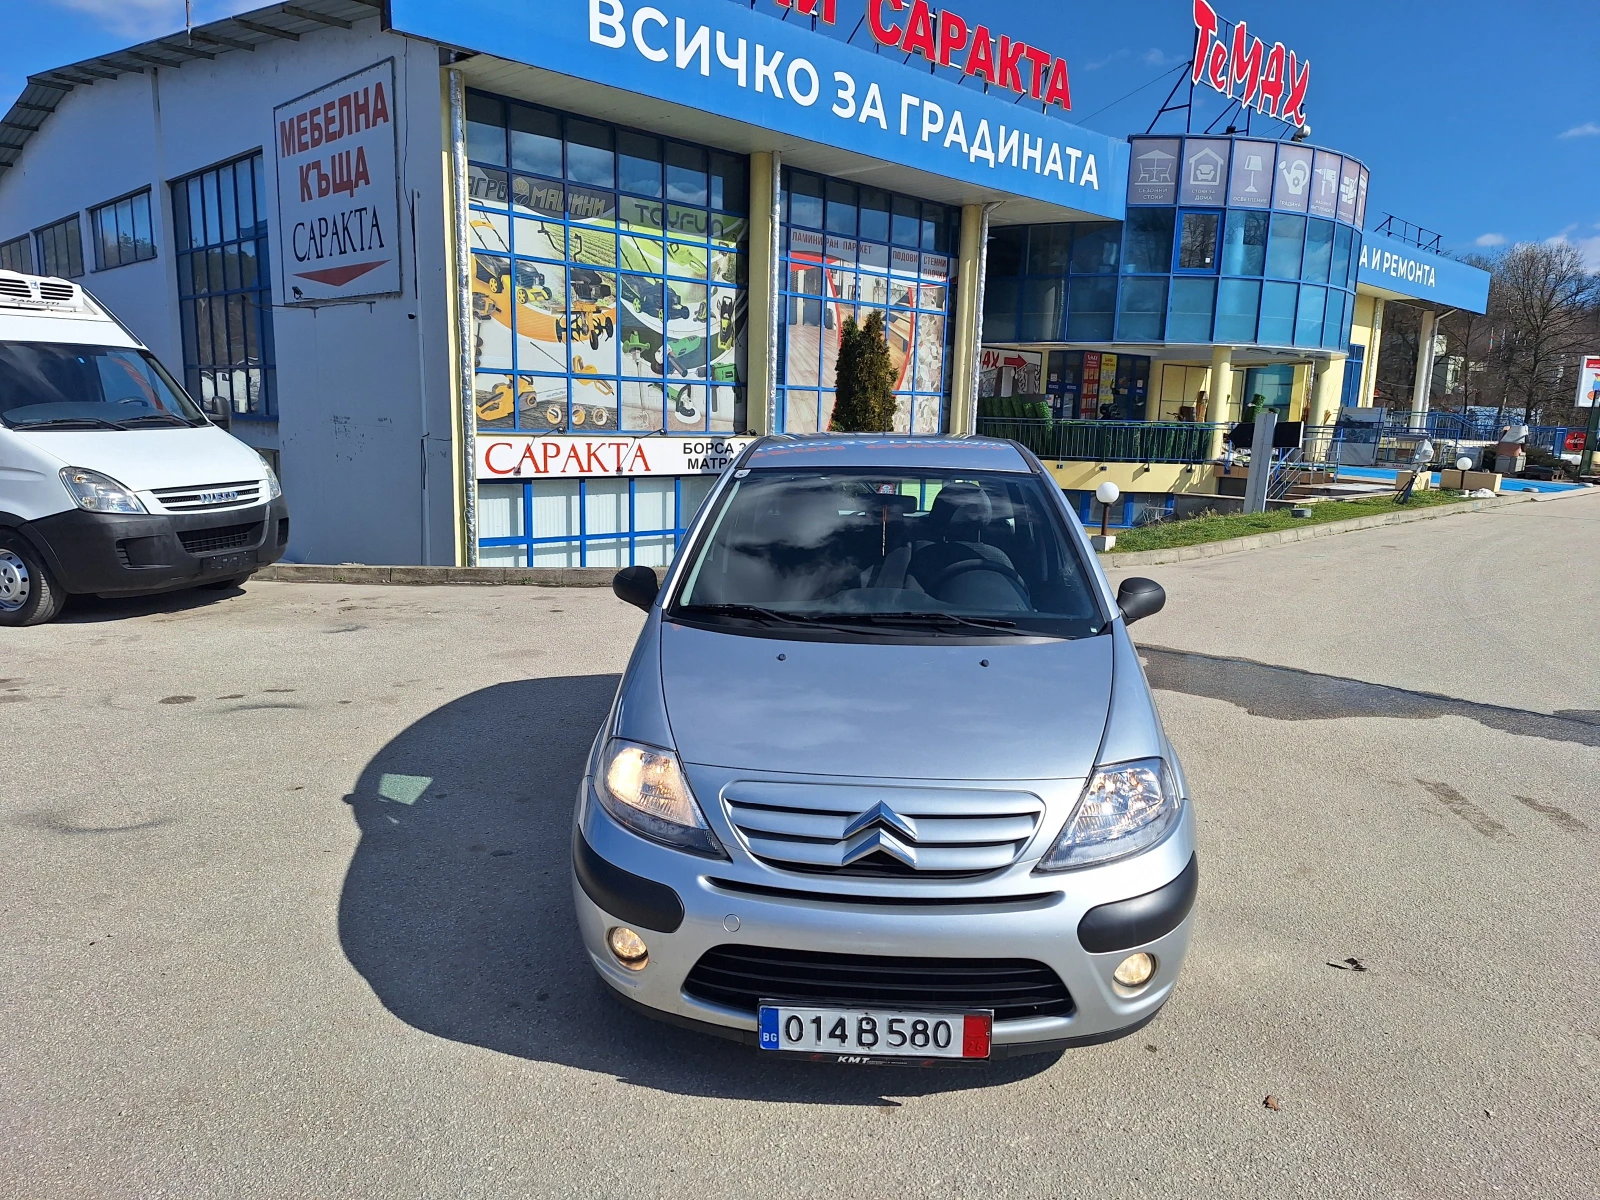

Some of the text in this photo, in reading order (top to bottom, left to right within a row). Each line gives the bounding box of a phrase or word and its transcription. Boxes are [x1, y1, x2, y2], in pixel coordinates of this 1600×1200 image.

[866, 0, 1072, 111] САРАКТА
[589, 0, 1099, 190] ВСИЧКО ЗА ГРАДИНАТА
[280, 81, 390, 158] МЕБЕЛНА
[299, 146, 371, 202] КЪЩА
[293, 205, 385, 262] САРАКТА
[892, 250, 918, 263] ПОДОВИ
[1371, 247, 1382, 271] И
[1382, 251, 1436, 288] РЕМОНТА
[10, 297, 60, 306] ZANOTTI
[484, 442, 652, 475] САРАКТА
[683, 442, 734, 454] БОРСА
[687, 457, 735, 470] МАТР
[762, 1032, 778, 1042] BG
[837, 1056, 871, 1064] KMT
